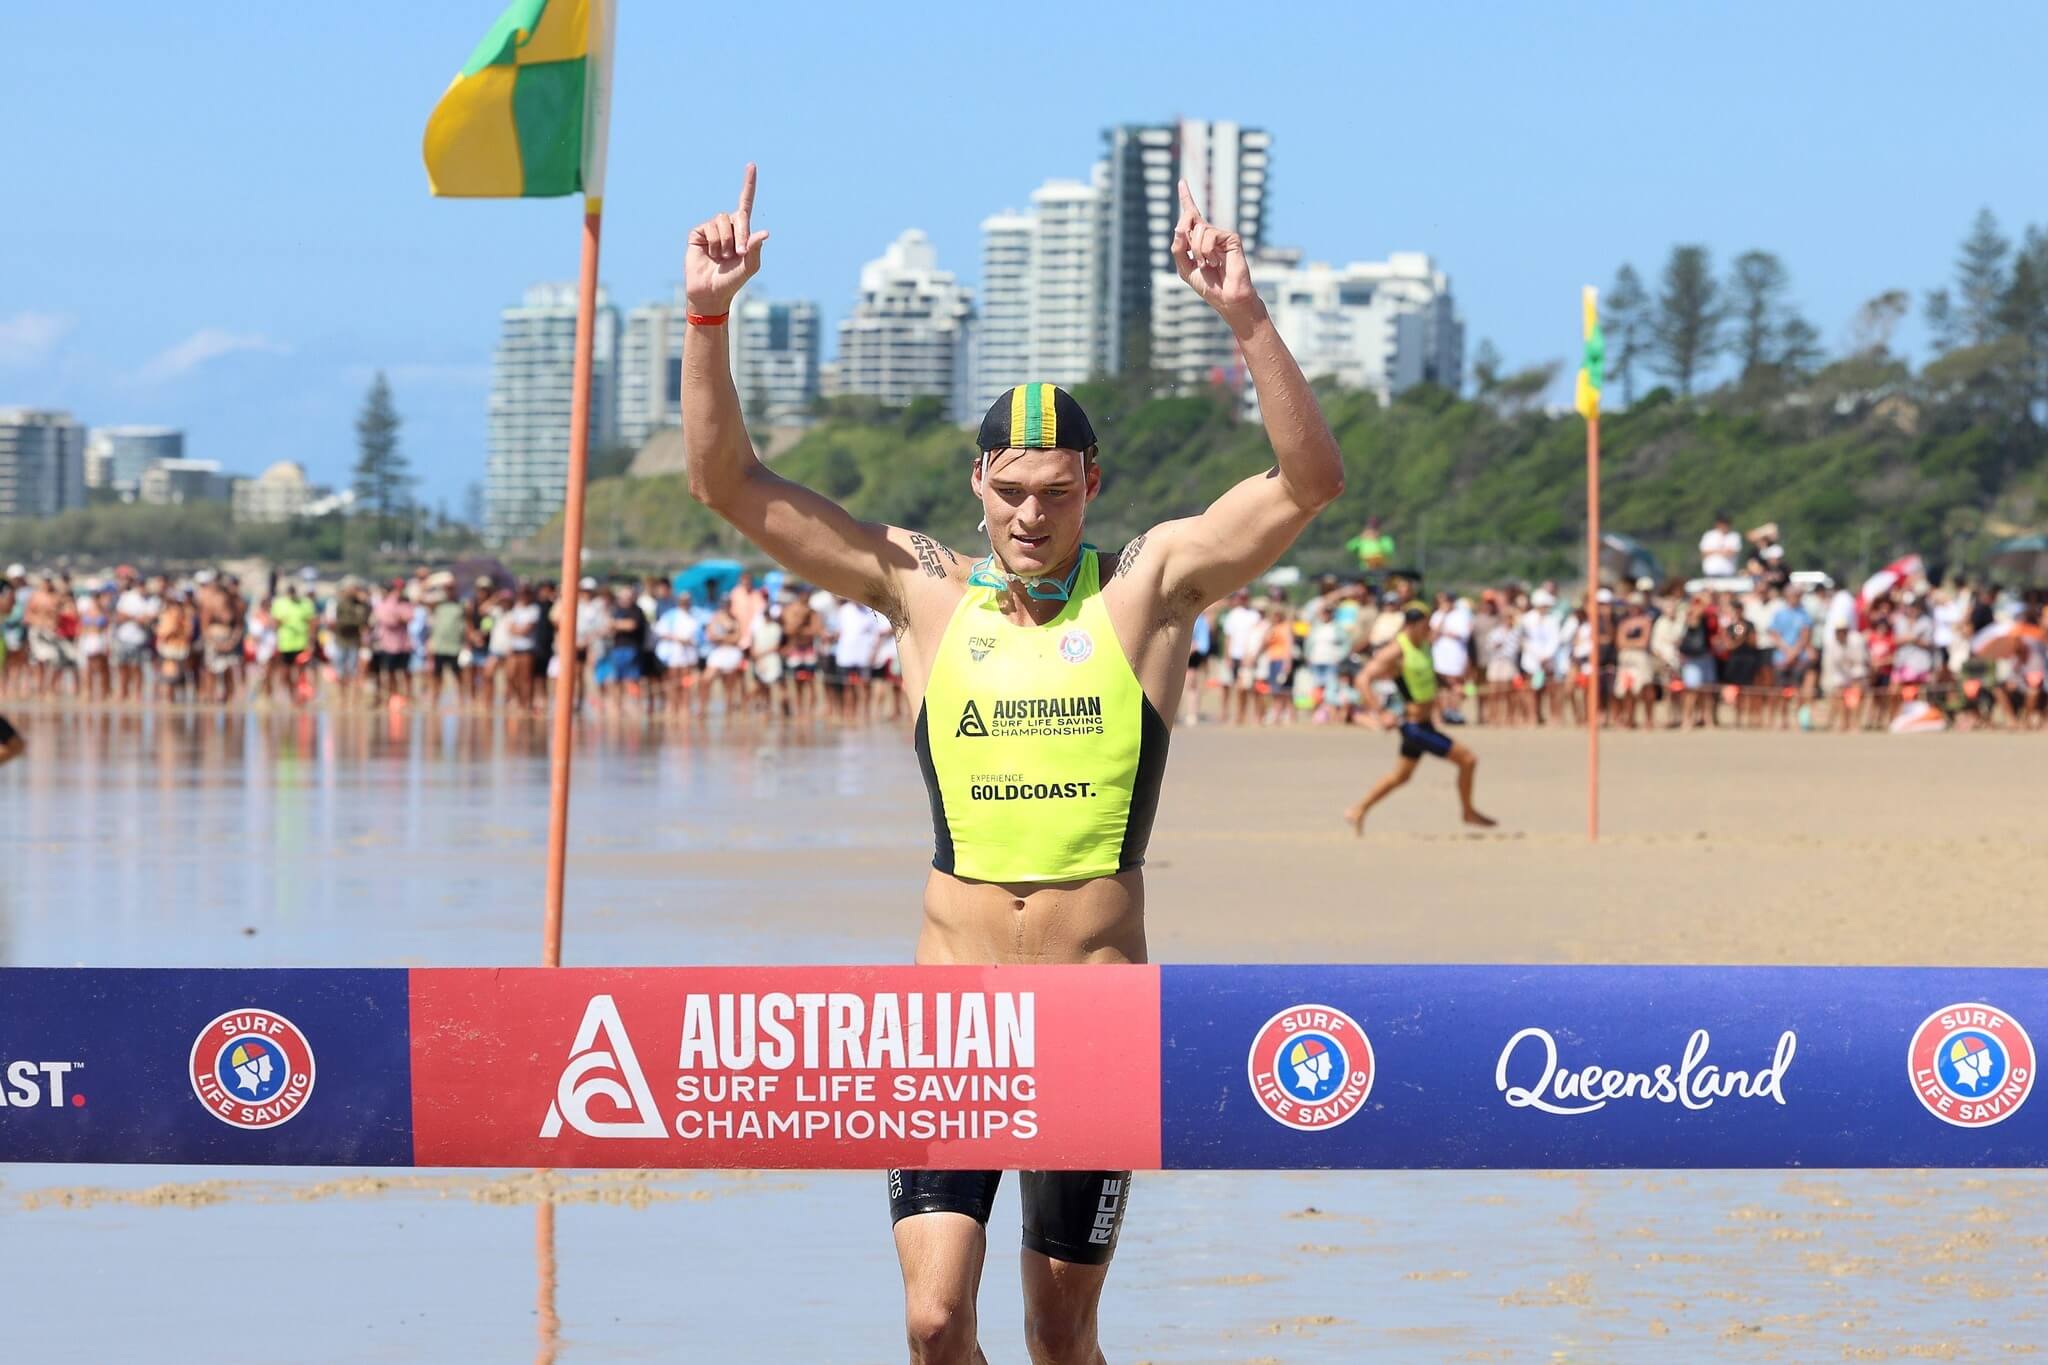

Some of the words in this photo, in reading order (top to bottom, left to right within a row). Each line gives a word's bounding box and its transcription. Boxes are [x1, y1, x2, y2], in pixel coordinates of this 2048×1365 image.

[968, 636, 996, 648] FINZ
[992, 719, 1023, 727] SURF
[1027, 718, 1052, 727] LIFE
[1057, 716, 1103, 726] SAVING
[993, 696, 1101, 719] AUSTRALIAN
[991, 726, 1104, 737] CHAMPIONSHIPS
[970, 774, 1025, 783] EXPERIENCE
[222, 1016, 284, 1036] SURF
[678, 992, 1036, 1070] AUSTRALIAN
[1281, 1012, 1344, 1033] SURF
[1941, 1010, 2004, 1030] SURF
[1495, 1027, 1797, 1115] Queensland
[198, 1073, 235, 1115] LIFE
[241, 1073, 307, 1122] SAVING
[675, 1075, 779, 1102] SURF
[796, 1075, 876, 1102] LIFE
[892, 1074, 1038, 1102] SAVING
[1256, 1072, 1293, 1116] LIFE
[1298, 1071, 1367, 1123] SAVING
[1916, 1068, 1954, 1112] LIFE
[1959, 1067, 2028, 1120] SAVING
[675, 1109, 1039, 1140] CHAMPIONSHIPS
[890, 1168, 903, 1199] ers
[1088, 1179, 1122, 1245] RACE
